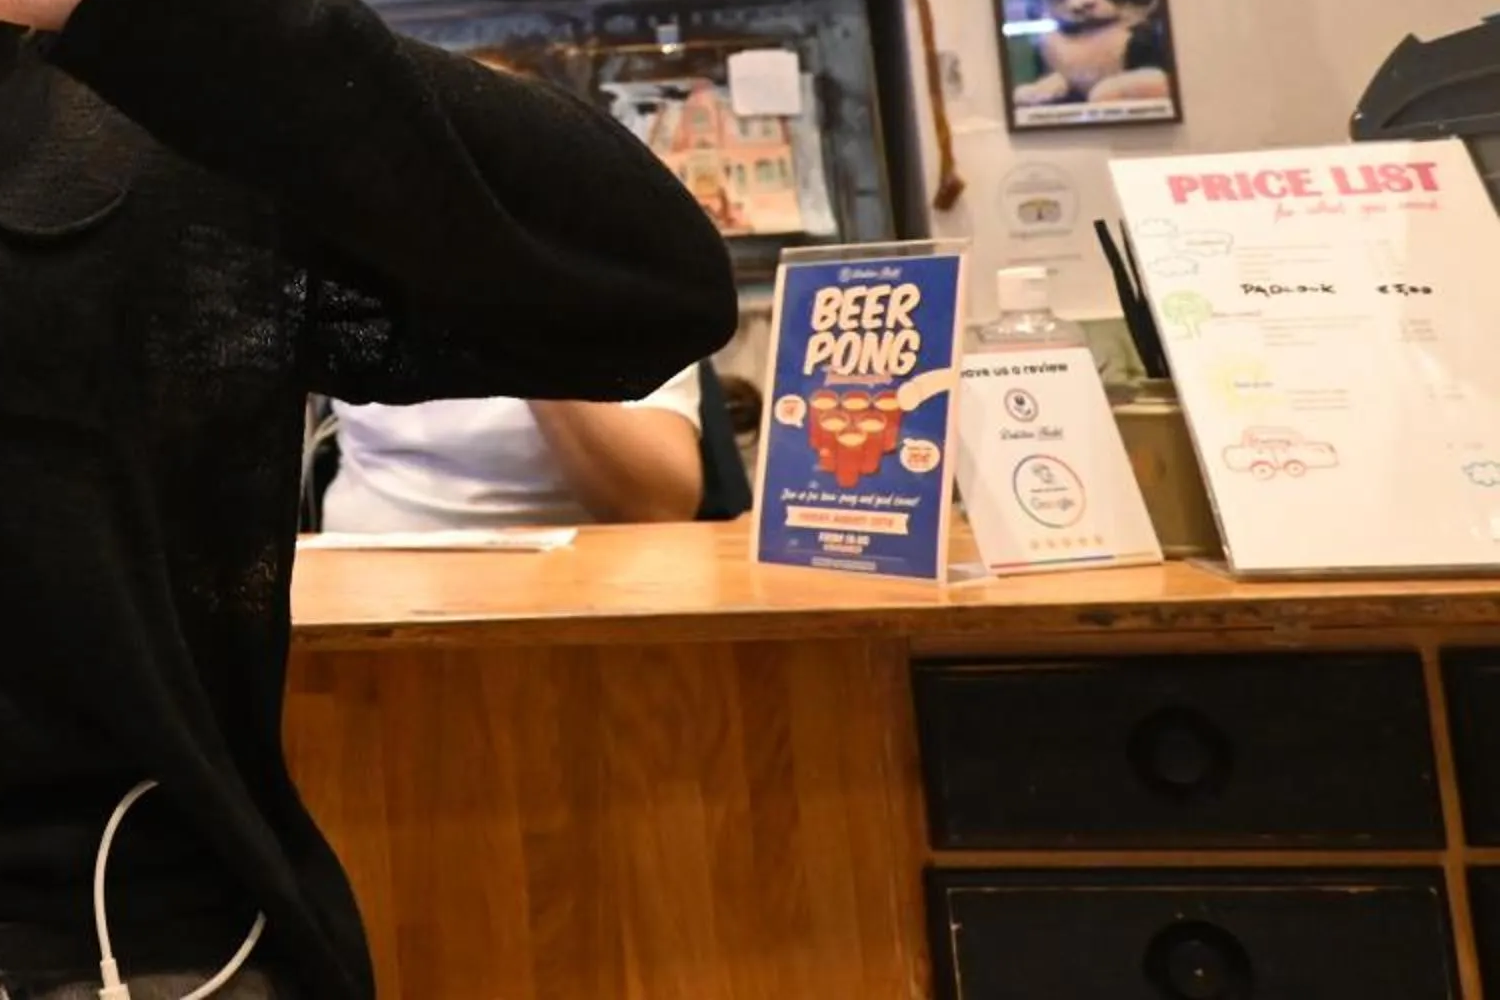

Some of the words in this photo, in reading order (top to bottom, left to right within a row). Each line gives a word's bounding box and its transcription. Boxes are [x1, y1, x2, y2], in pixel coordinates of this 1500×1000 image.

[1166, 168, 1323, 205] PRICE
[1329, 161, 1439, 196] LIST
[811, 282, 921, 331] BEER
[803, 328, 921, 376] PONG
[1023, 362, 1068, 374] review
